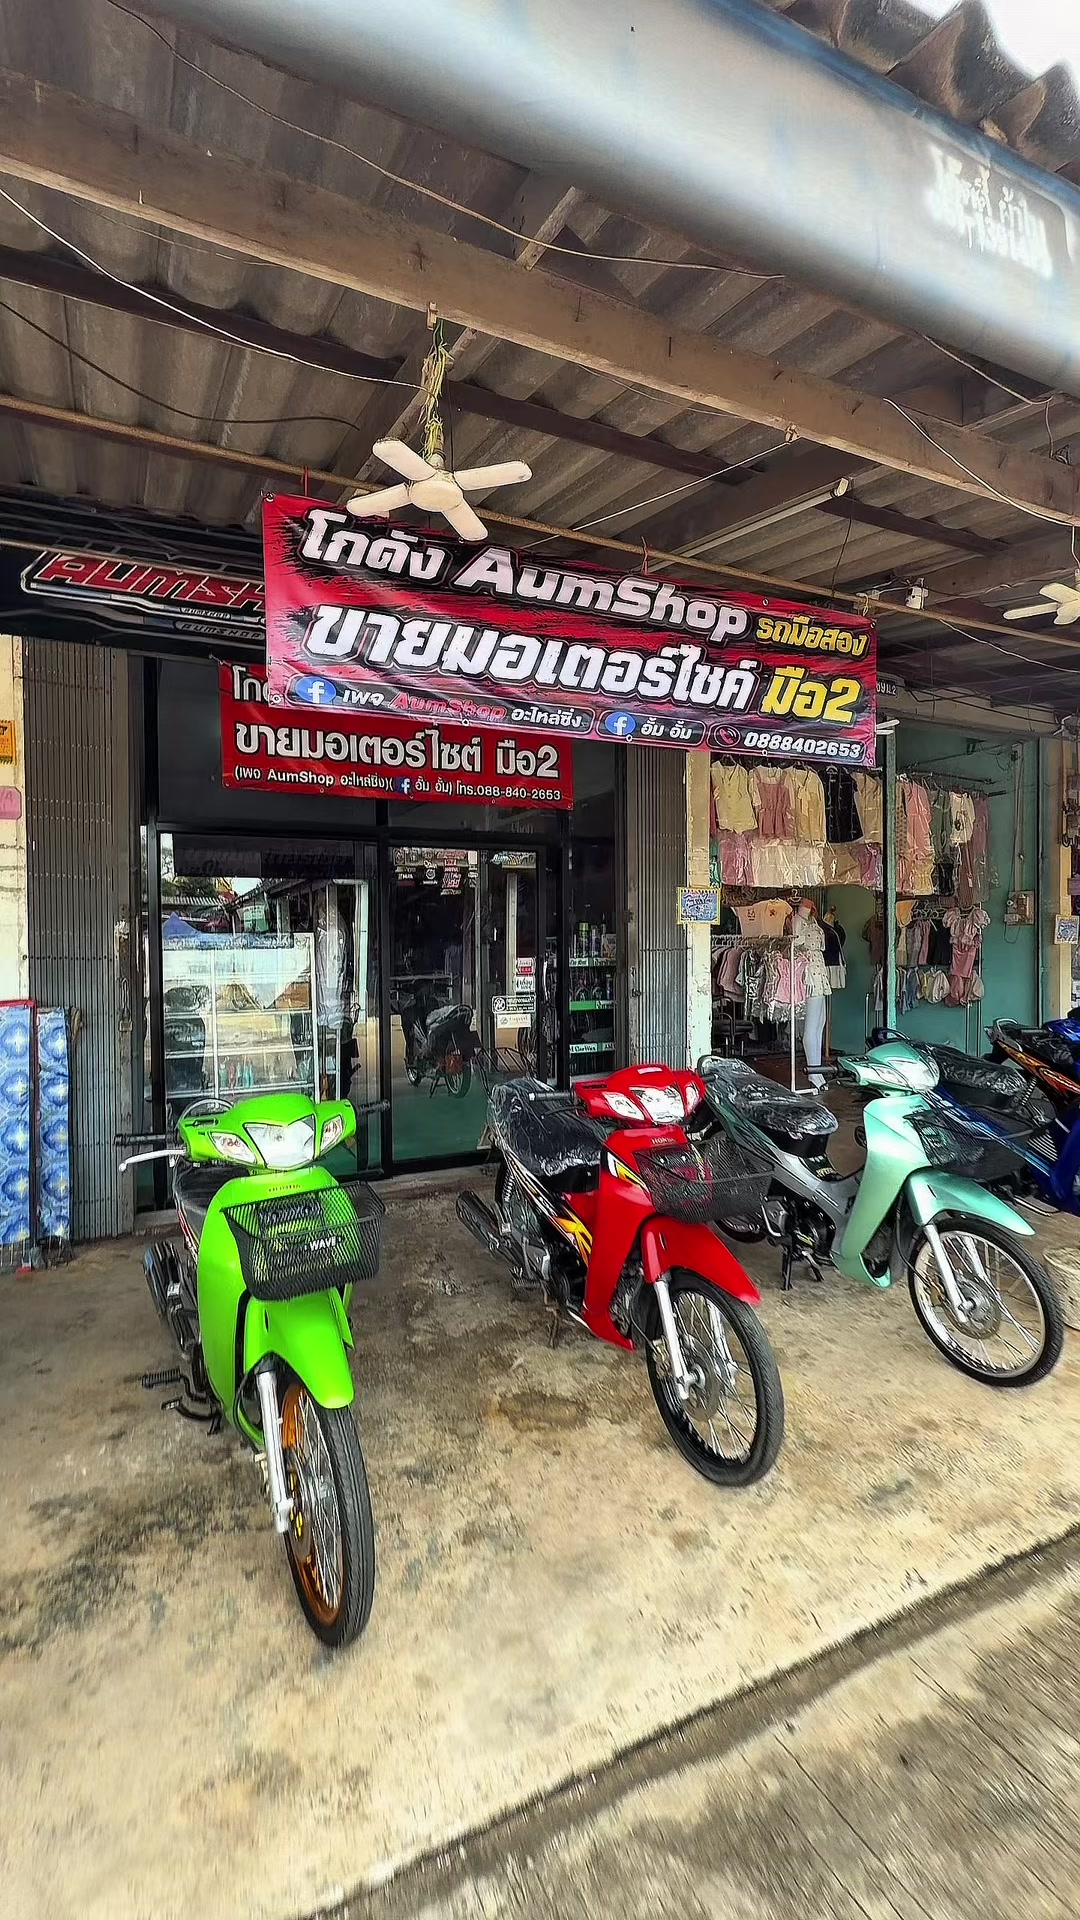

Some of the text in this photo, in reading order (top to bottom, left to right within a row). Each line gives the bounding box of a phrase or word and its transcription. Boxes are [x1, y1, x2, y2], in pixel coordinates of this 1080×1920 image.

[302, 509, 869, 656] โกดัง AumShop รถมือสอง
[342, 689, 385, 709] เพจ
[389, 692, 507, 721] AumShop
[761, 665, 862, 723] มือ2
[495, 738, 560, 778] มือ2
[743, 731, 862, 758] 0888402653
[267, 768, 335, 786] AumShop
